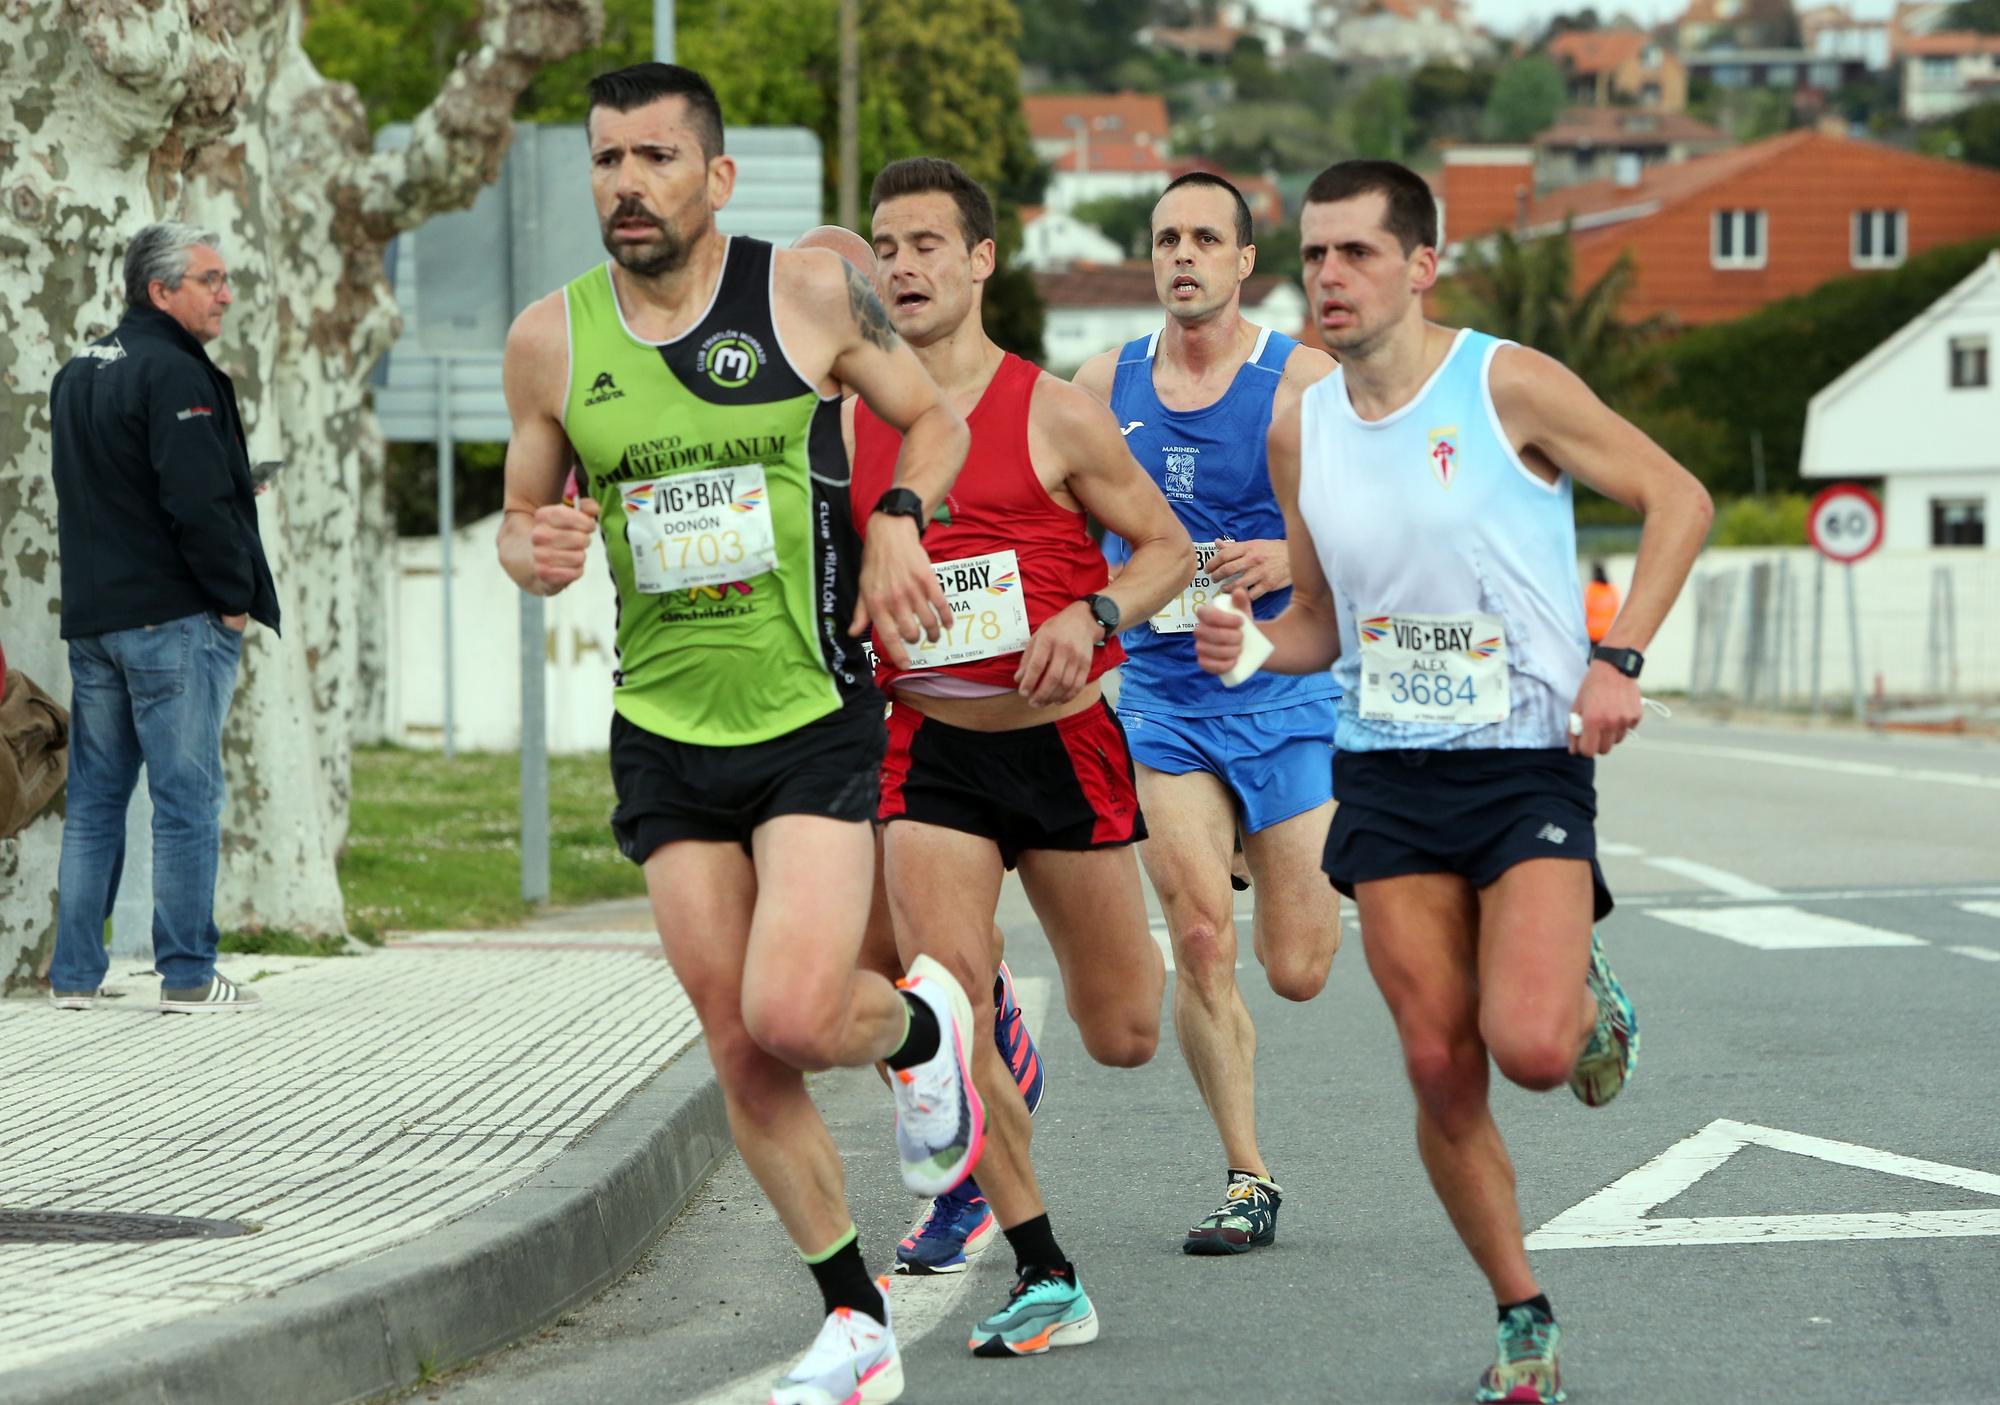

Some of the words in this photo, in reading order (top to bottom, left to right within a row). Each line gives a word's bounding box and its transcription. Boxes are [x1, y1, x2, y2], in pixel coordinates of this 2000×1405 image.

[629, 436, 682, 457] BANCO
[632, 435, 786, 476] MEDIOLANUM
[1161, 446, 1200, 454] MARINEDA
[664, 517, 721, 535] DONÓN
[819, 500, 831, 539] CLUB
[652, 529, 746, 572] 1703
[954, 565, 990, 592] BAY
[1433, 627, 1473, 651] BAY
[1412, 659, 1448, 672] ALEX
[1389, 671, 1478, 707] 3684
